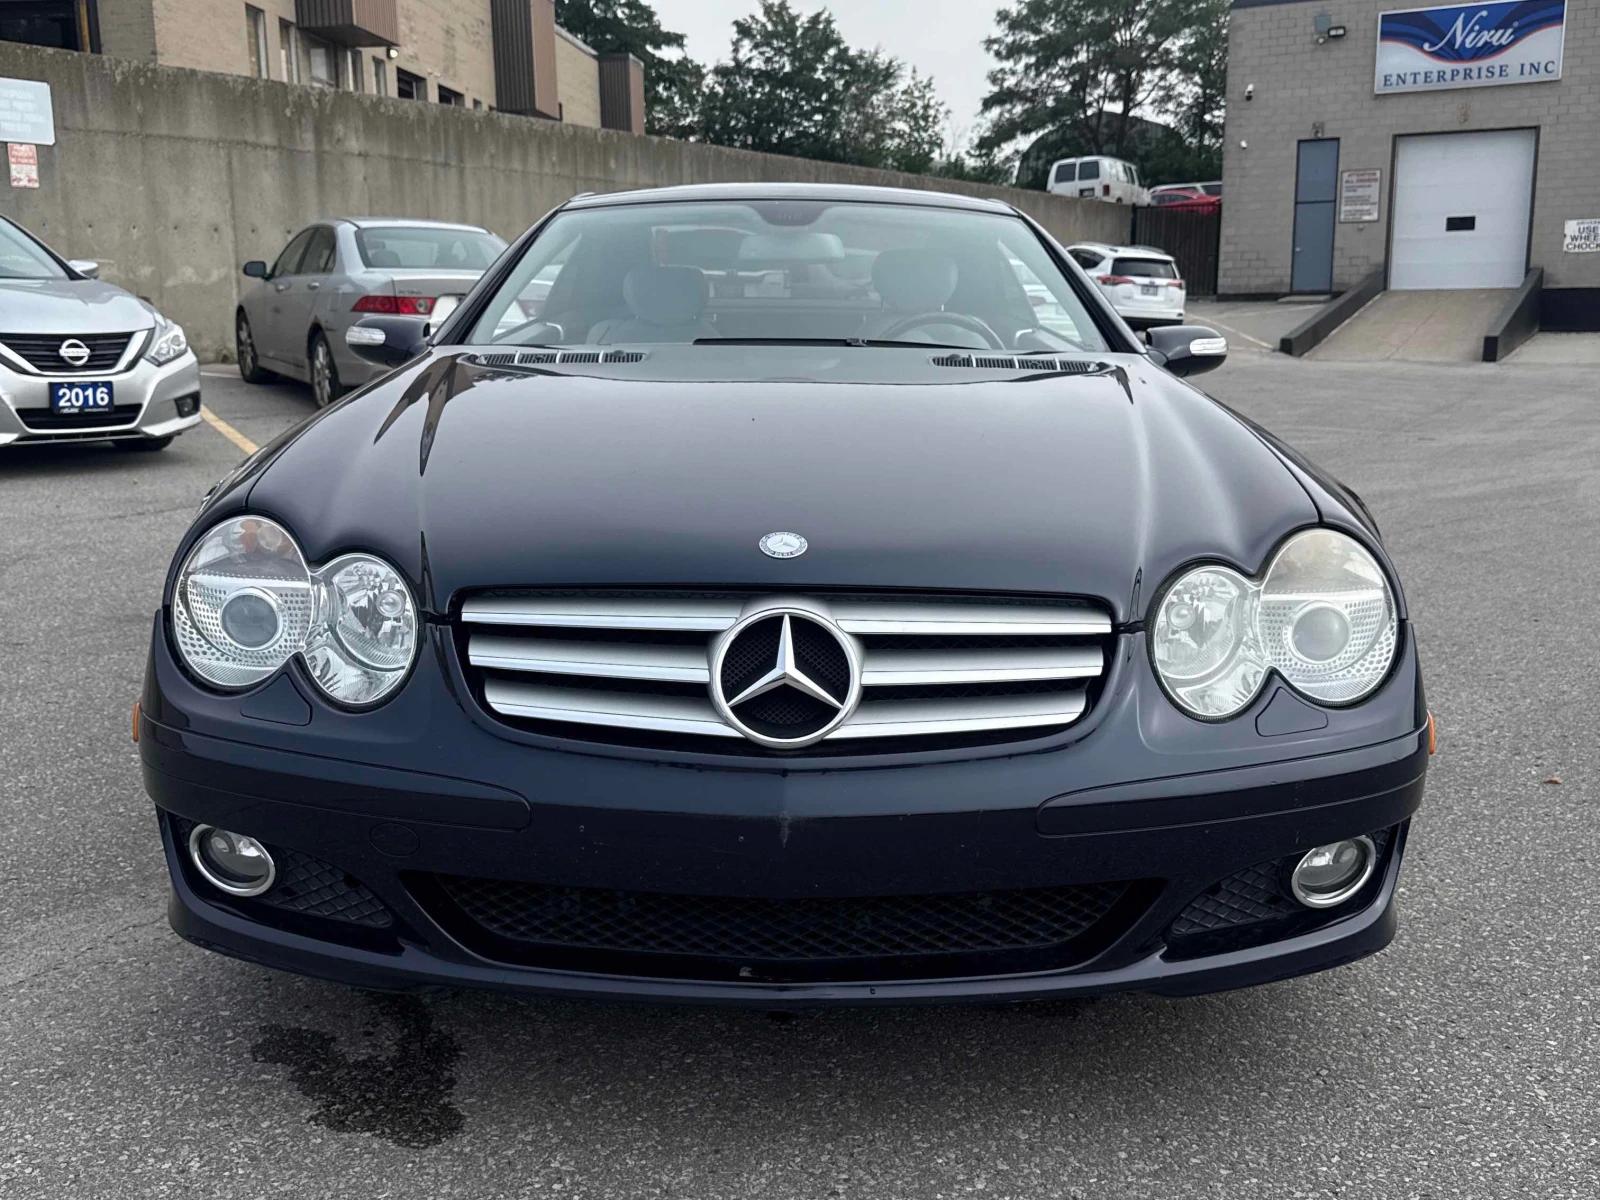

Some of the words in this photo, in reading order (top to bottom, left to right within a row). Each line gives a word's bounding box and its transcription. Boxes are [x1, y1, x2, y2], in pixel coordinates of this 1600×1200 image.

[1423, 10, 1515, 52] Niru
[1383, 64, 1509, 88] ENTERPRISE
[1520, 60, 1556, 77] INC
[1570, 233, 1599, 242] WHEE
[1578, 225, 1599, 235] USE
[58, 387, 109, 407] 2016
